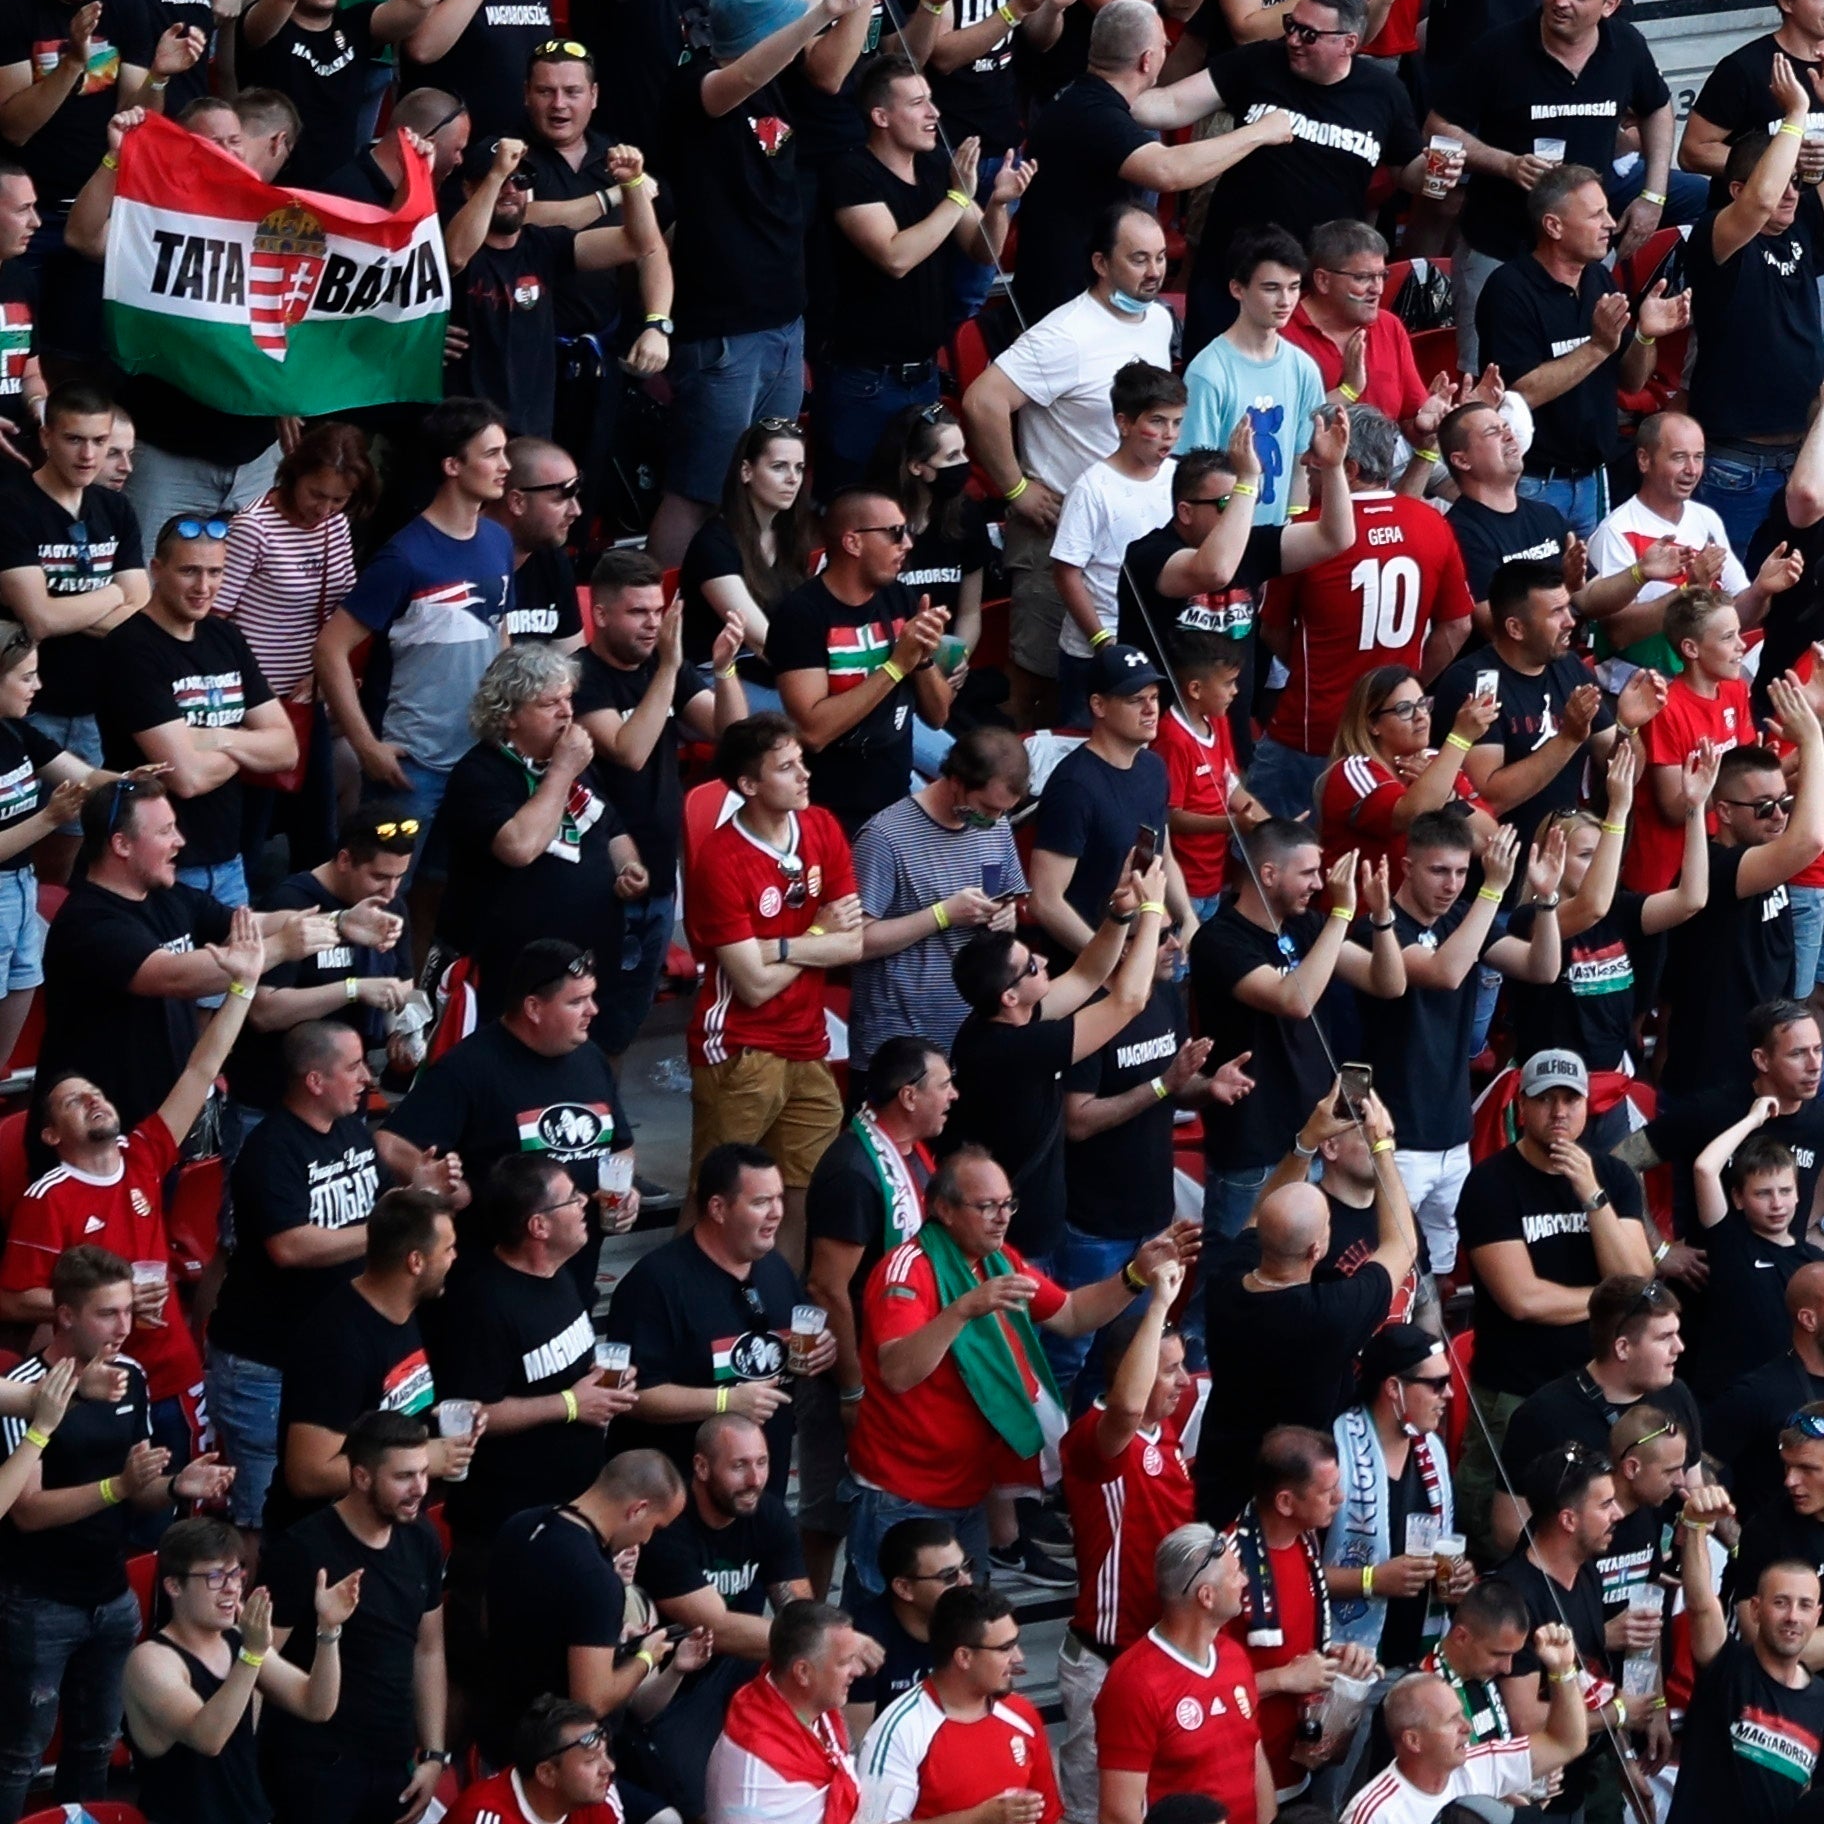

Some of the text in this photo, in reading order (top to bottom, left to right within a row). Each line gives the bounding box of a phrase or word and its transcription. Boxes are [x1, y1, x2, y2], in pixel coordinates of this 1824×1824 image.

[1531, 99, 1618, 122] MAGYARORSZÁG
[151, 230, 246, 307] TATA
[1366, 525, 1404, 547] GERA
[1350, 555, 1422, 653] 10
[1535, 1057, 1578, 1077] HILFIGER
